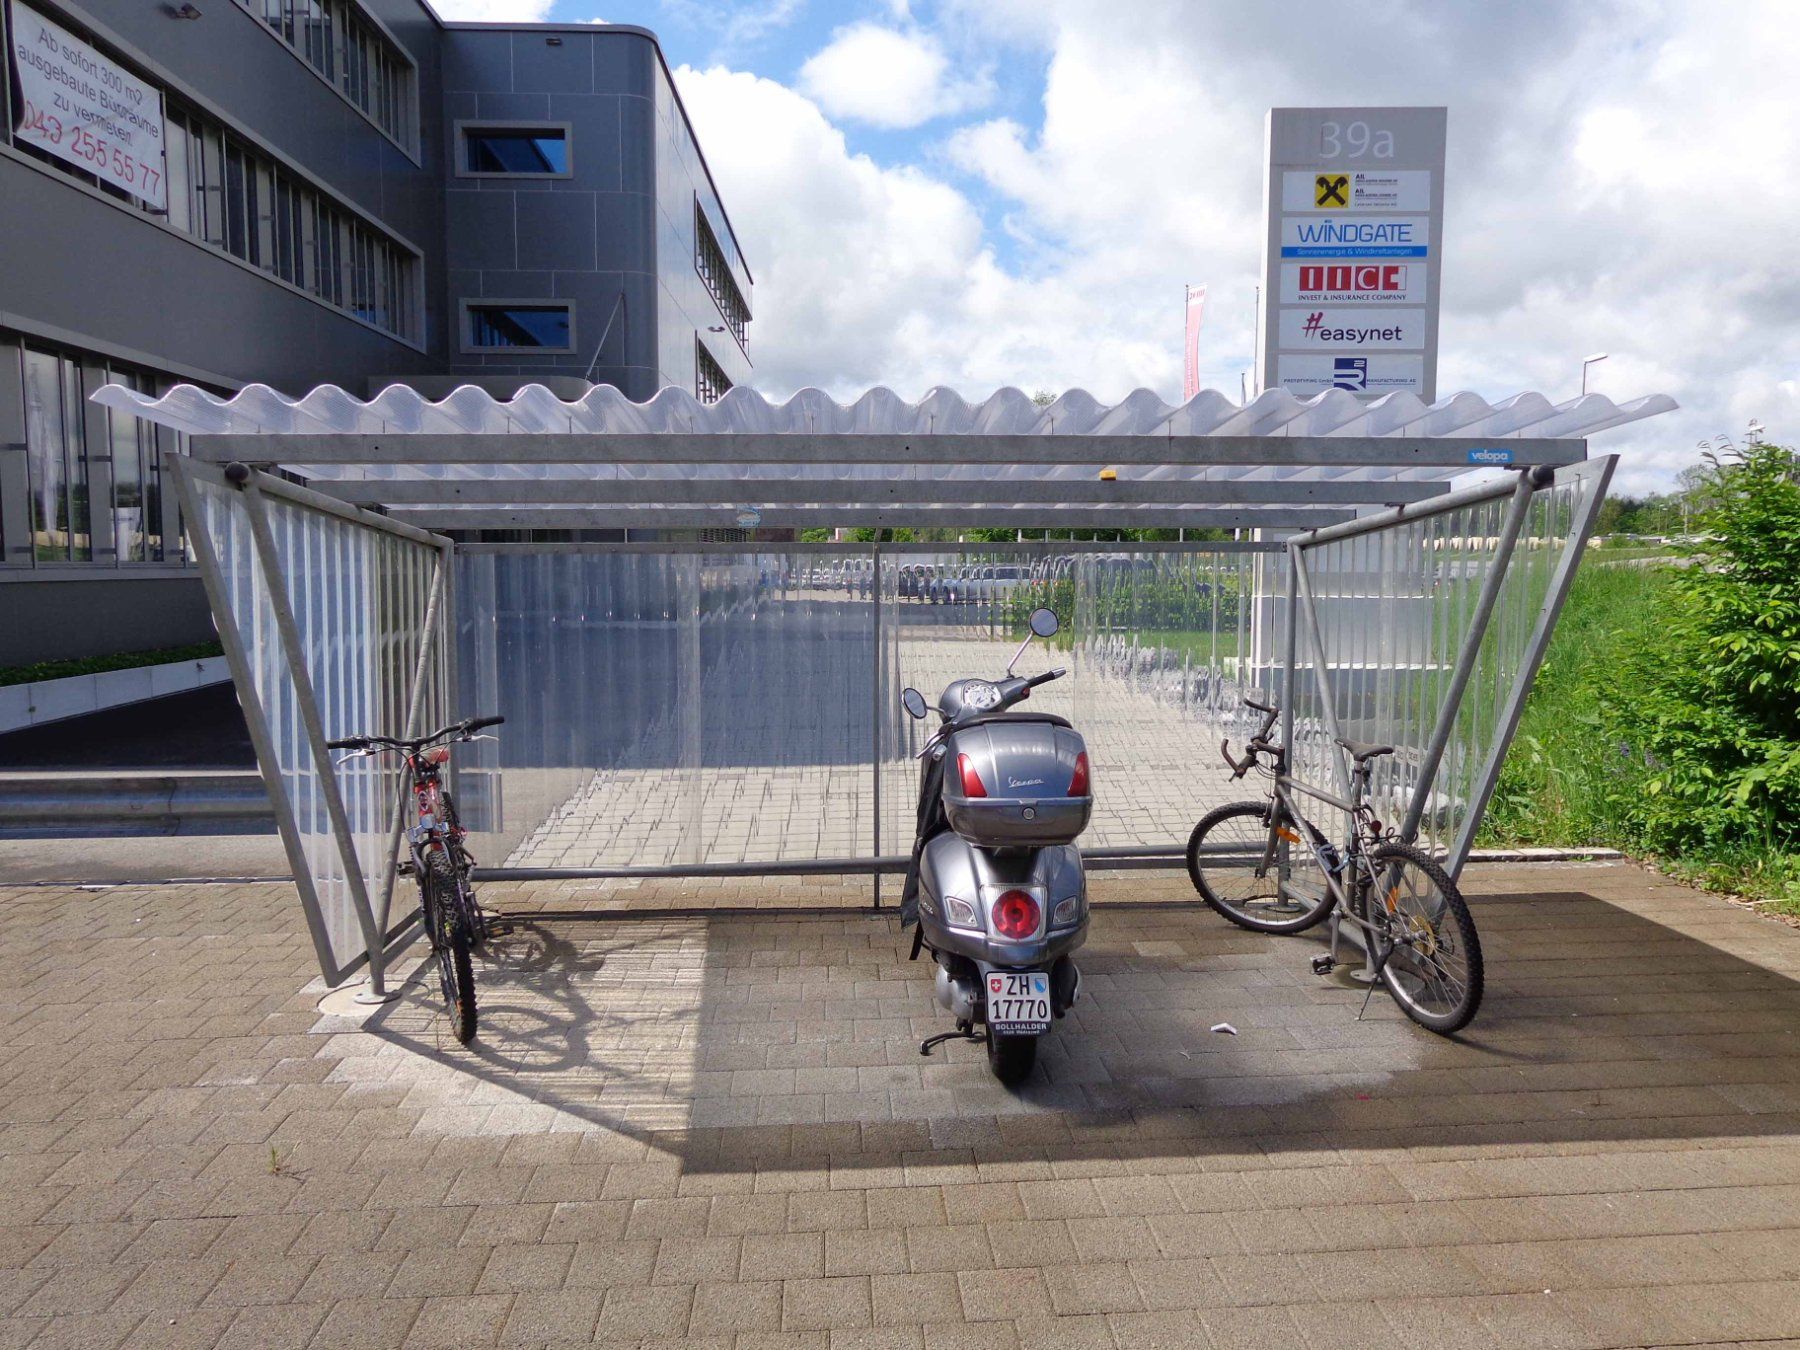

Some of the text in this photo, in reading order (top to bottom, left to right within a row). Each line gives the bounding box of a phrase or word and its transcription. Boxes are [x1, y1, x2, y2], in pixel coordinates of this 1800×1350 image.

[38, 28, 59, 53] Ab
[62, 46, 98, 79] sofort
[100, 66, 123, 92] 300
[18, 45, 159, 138] ausgebaute Büroräume
[54, 92, 70, 112] zu
[24, 101, 161, 196] 043 255 55 77
[1319, 121, 1394, 159] 39a
[1471, 449, 1508, 463] velopa
[1007, 775, 1045, 788] Vespa
[1006, 975, 1030, 996] ZH
[992, 999, 1048, 1020] 17770
